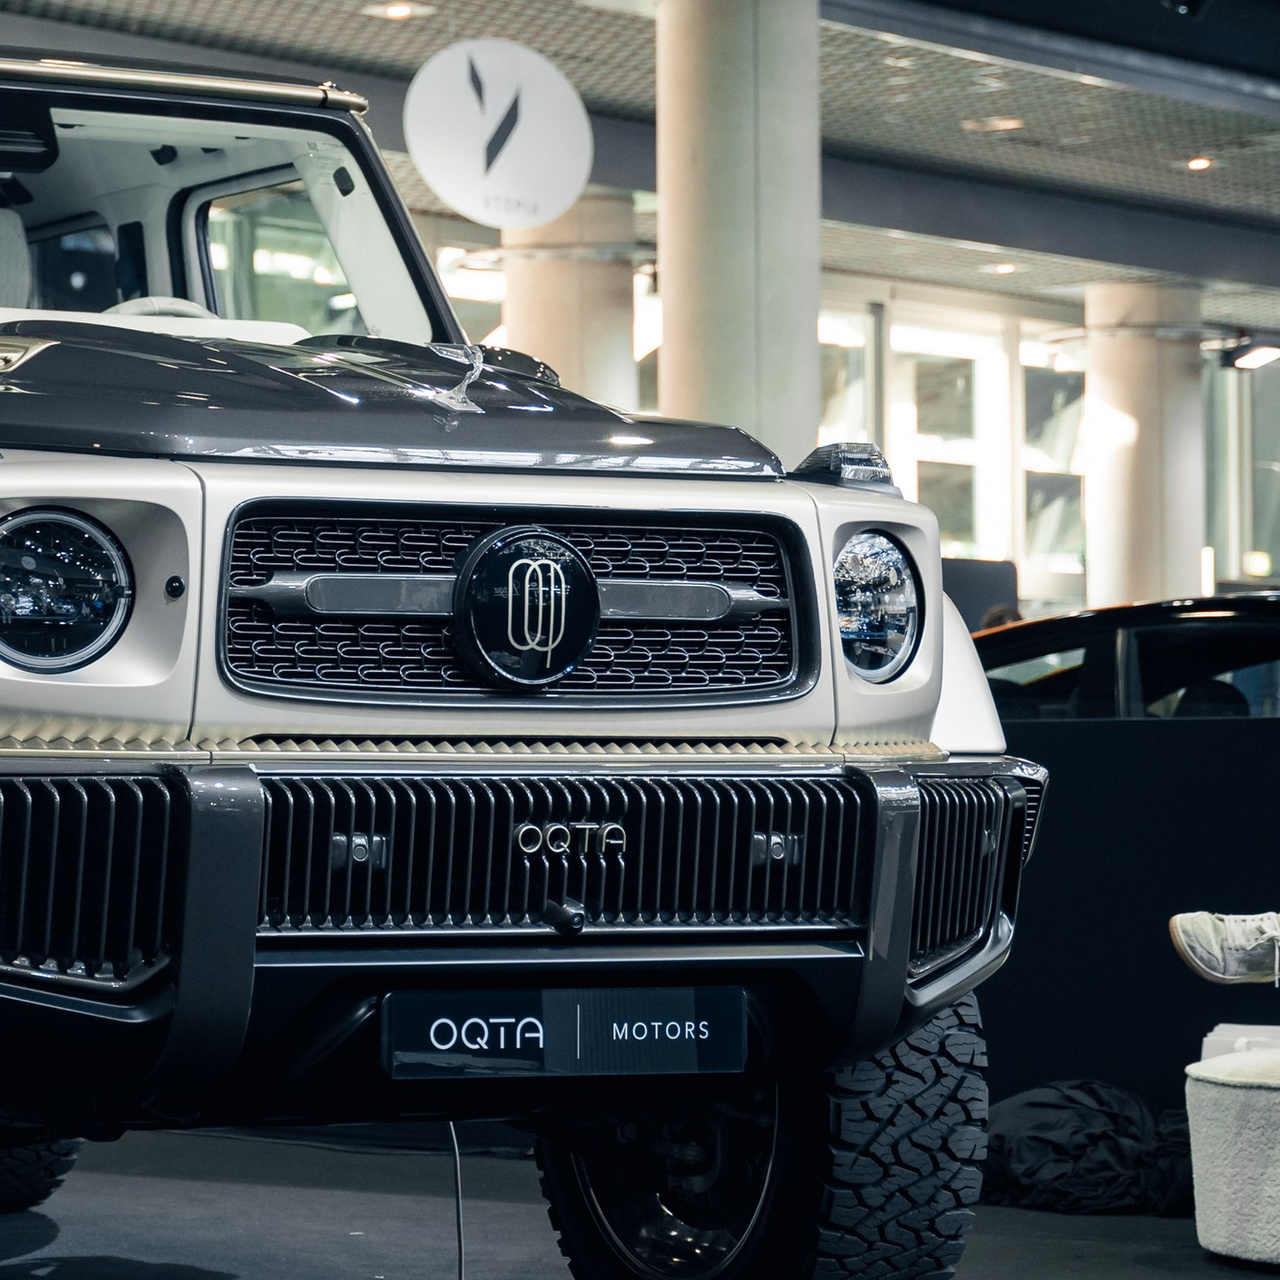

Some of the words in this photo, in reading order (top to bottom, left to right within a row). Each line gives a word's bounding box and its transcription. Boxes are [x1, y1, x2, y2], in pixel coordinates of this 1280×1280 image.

[516, 822, 627, 854] OQTA
[429, 1017, 544, 1050] OQTA
[612, 1021, 709, 1041] MOTORS
